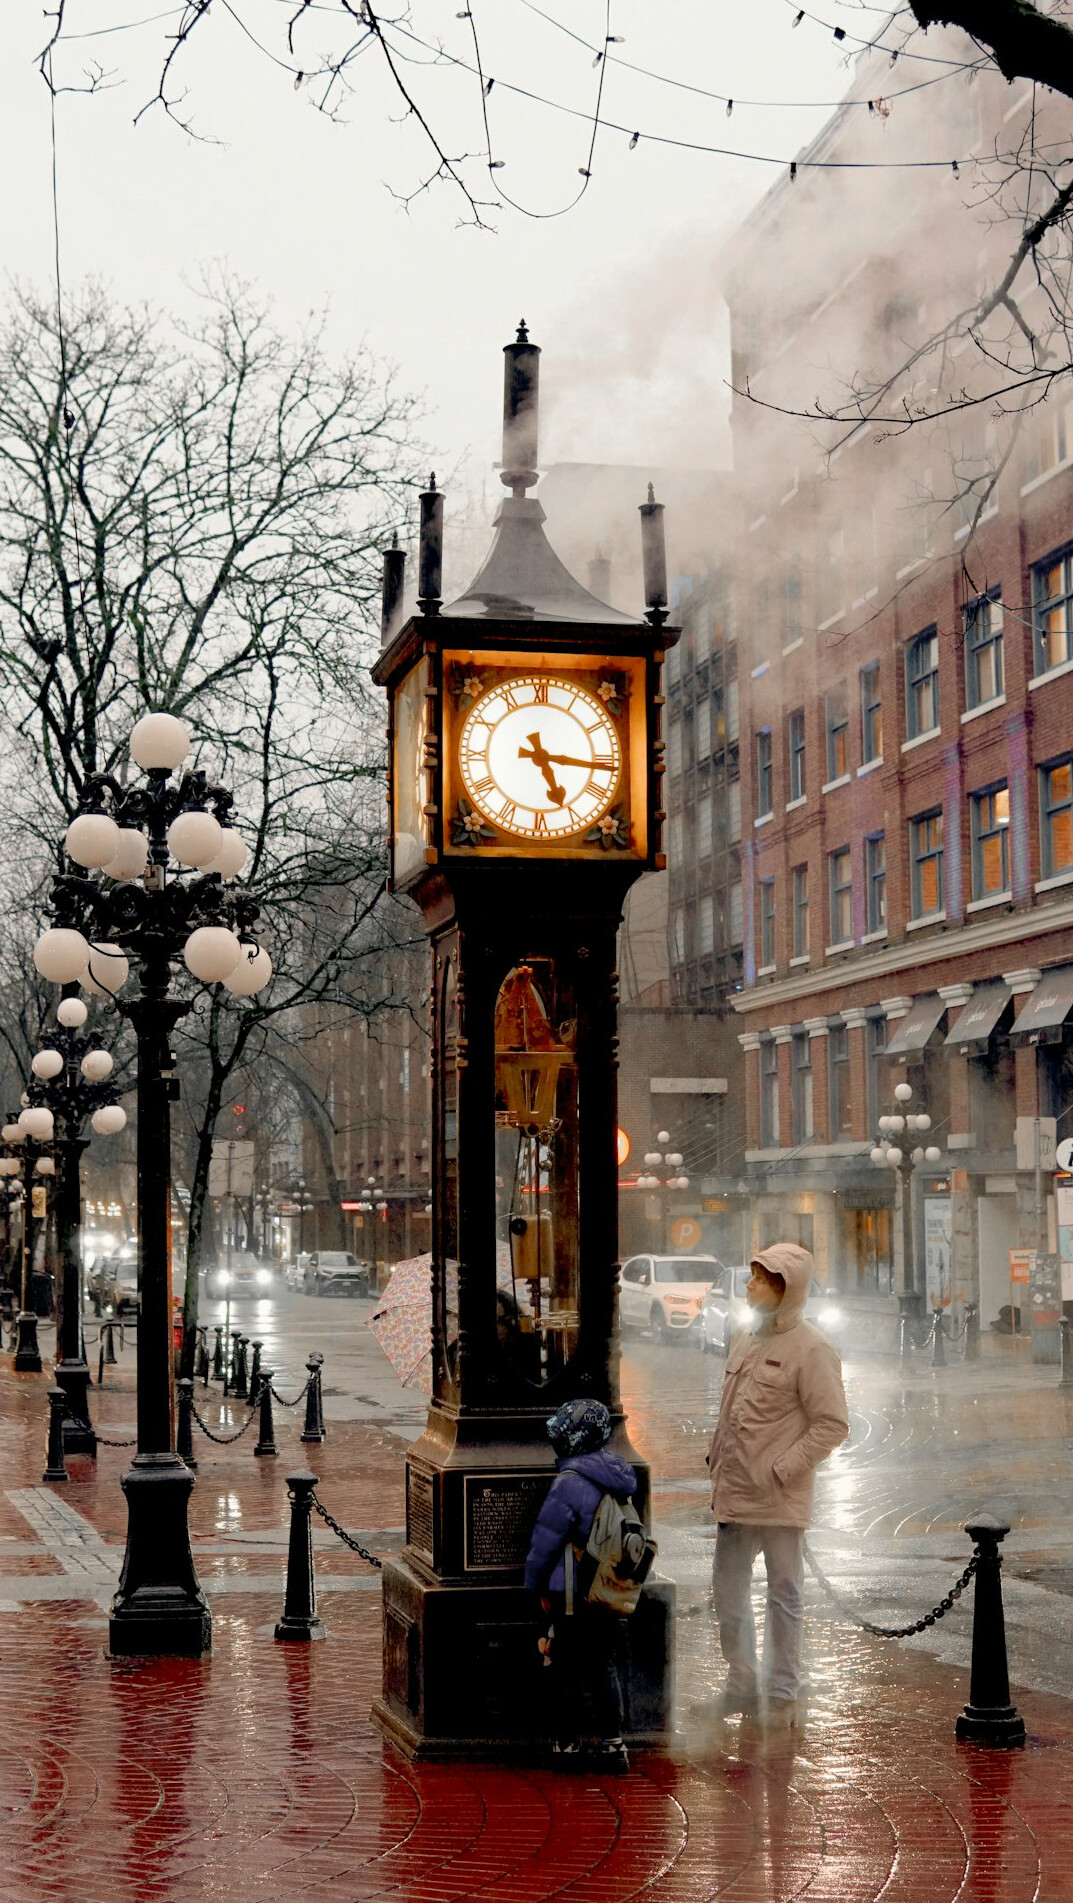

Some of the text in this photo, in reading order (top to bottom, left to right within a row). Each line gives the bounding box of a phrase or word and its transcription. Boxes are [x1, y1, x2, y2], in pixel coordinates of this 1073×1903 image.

[500, 690, 518, 711] XI
[533, 685, 549, 703] XII
[567, 694, 579, 711] I
[475, 716, 495, 732] X
[586, 722, 604, 734] II
[468, 749, 486, 761] IX
[474, 776, 495, 799] VIII
[500, 800, 517, 827] VII
[534, 812, 547, 830] VI
[568, 806, 582, 823] V
[679, 1223, 694, 1244] P
